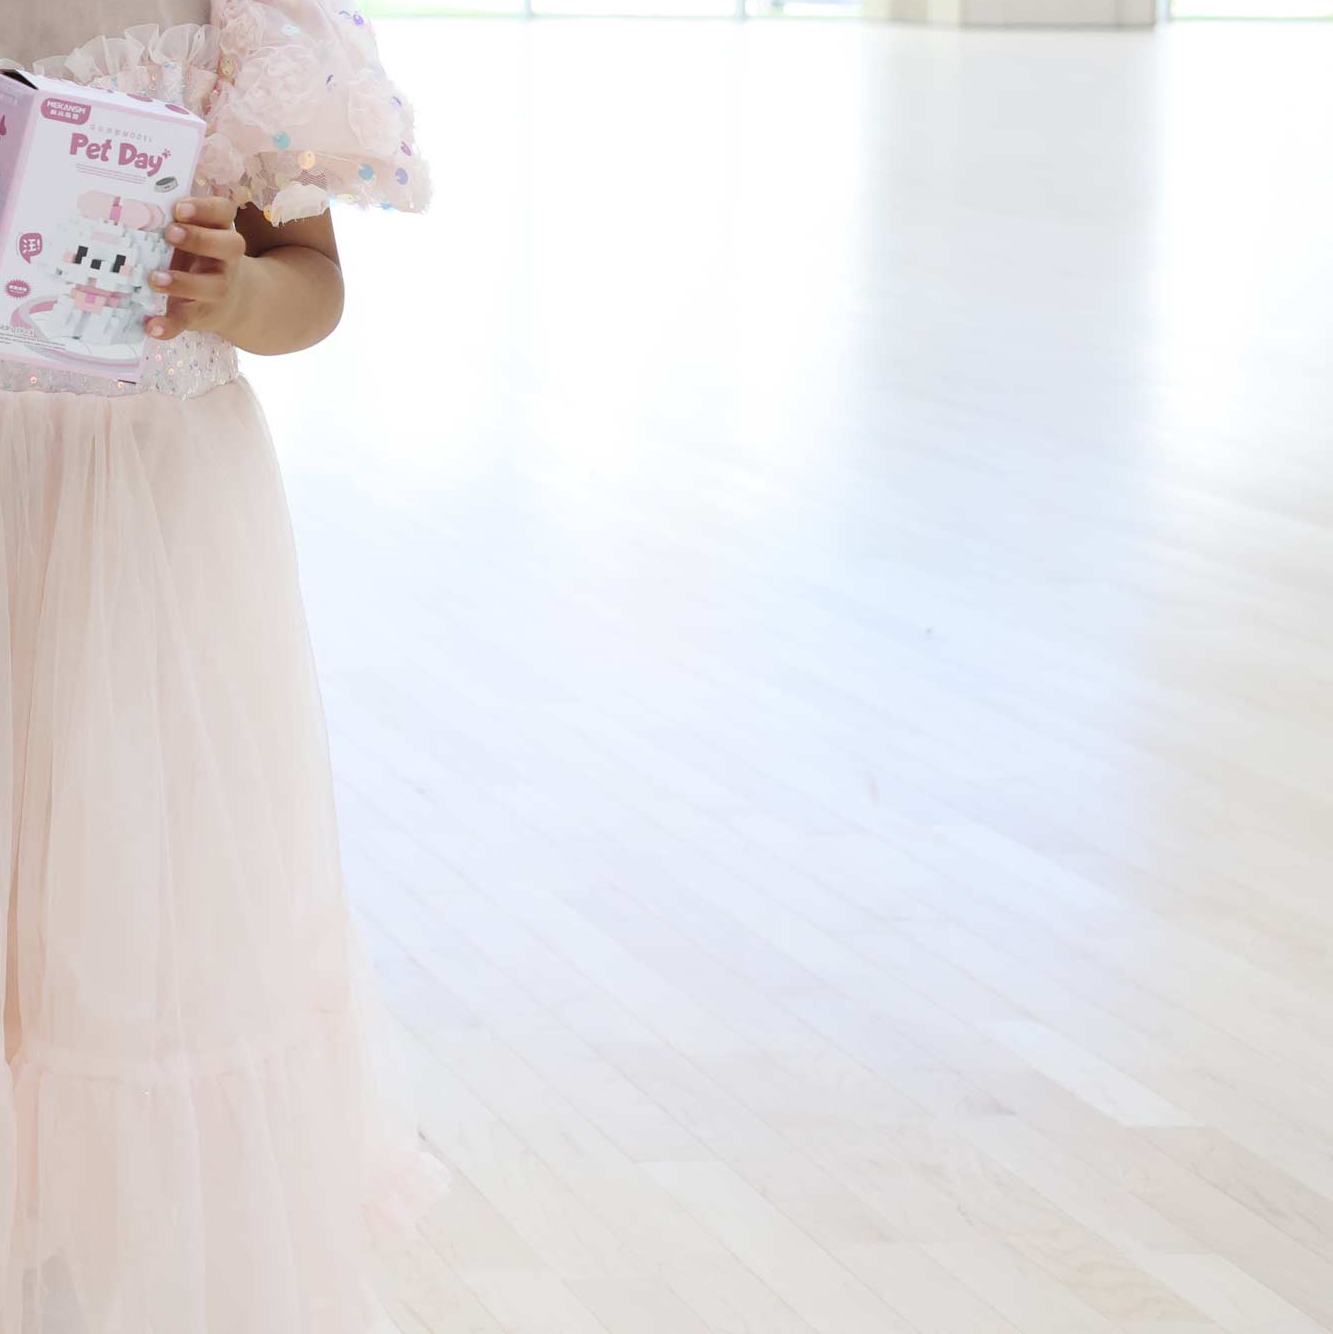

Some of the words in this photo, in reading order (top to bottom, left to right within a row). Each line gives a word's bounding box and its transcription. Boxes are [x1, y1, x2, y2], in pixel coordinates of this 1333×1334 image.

[46, 99, 86, 115] MEKANSM
[69, 132, 112, 162] Pet
[118, 142, 164, 177] Day
